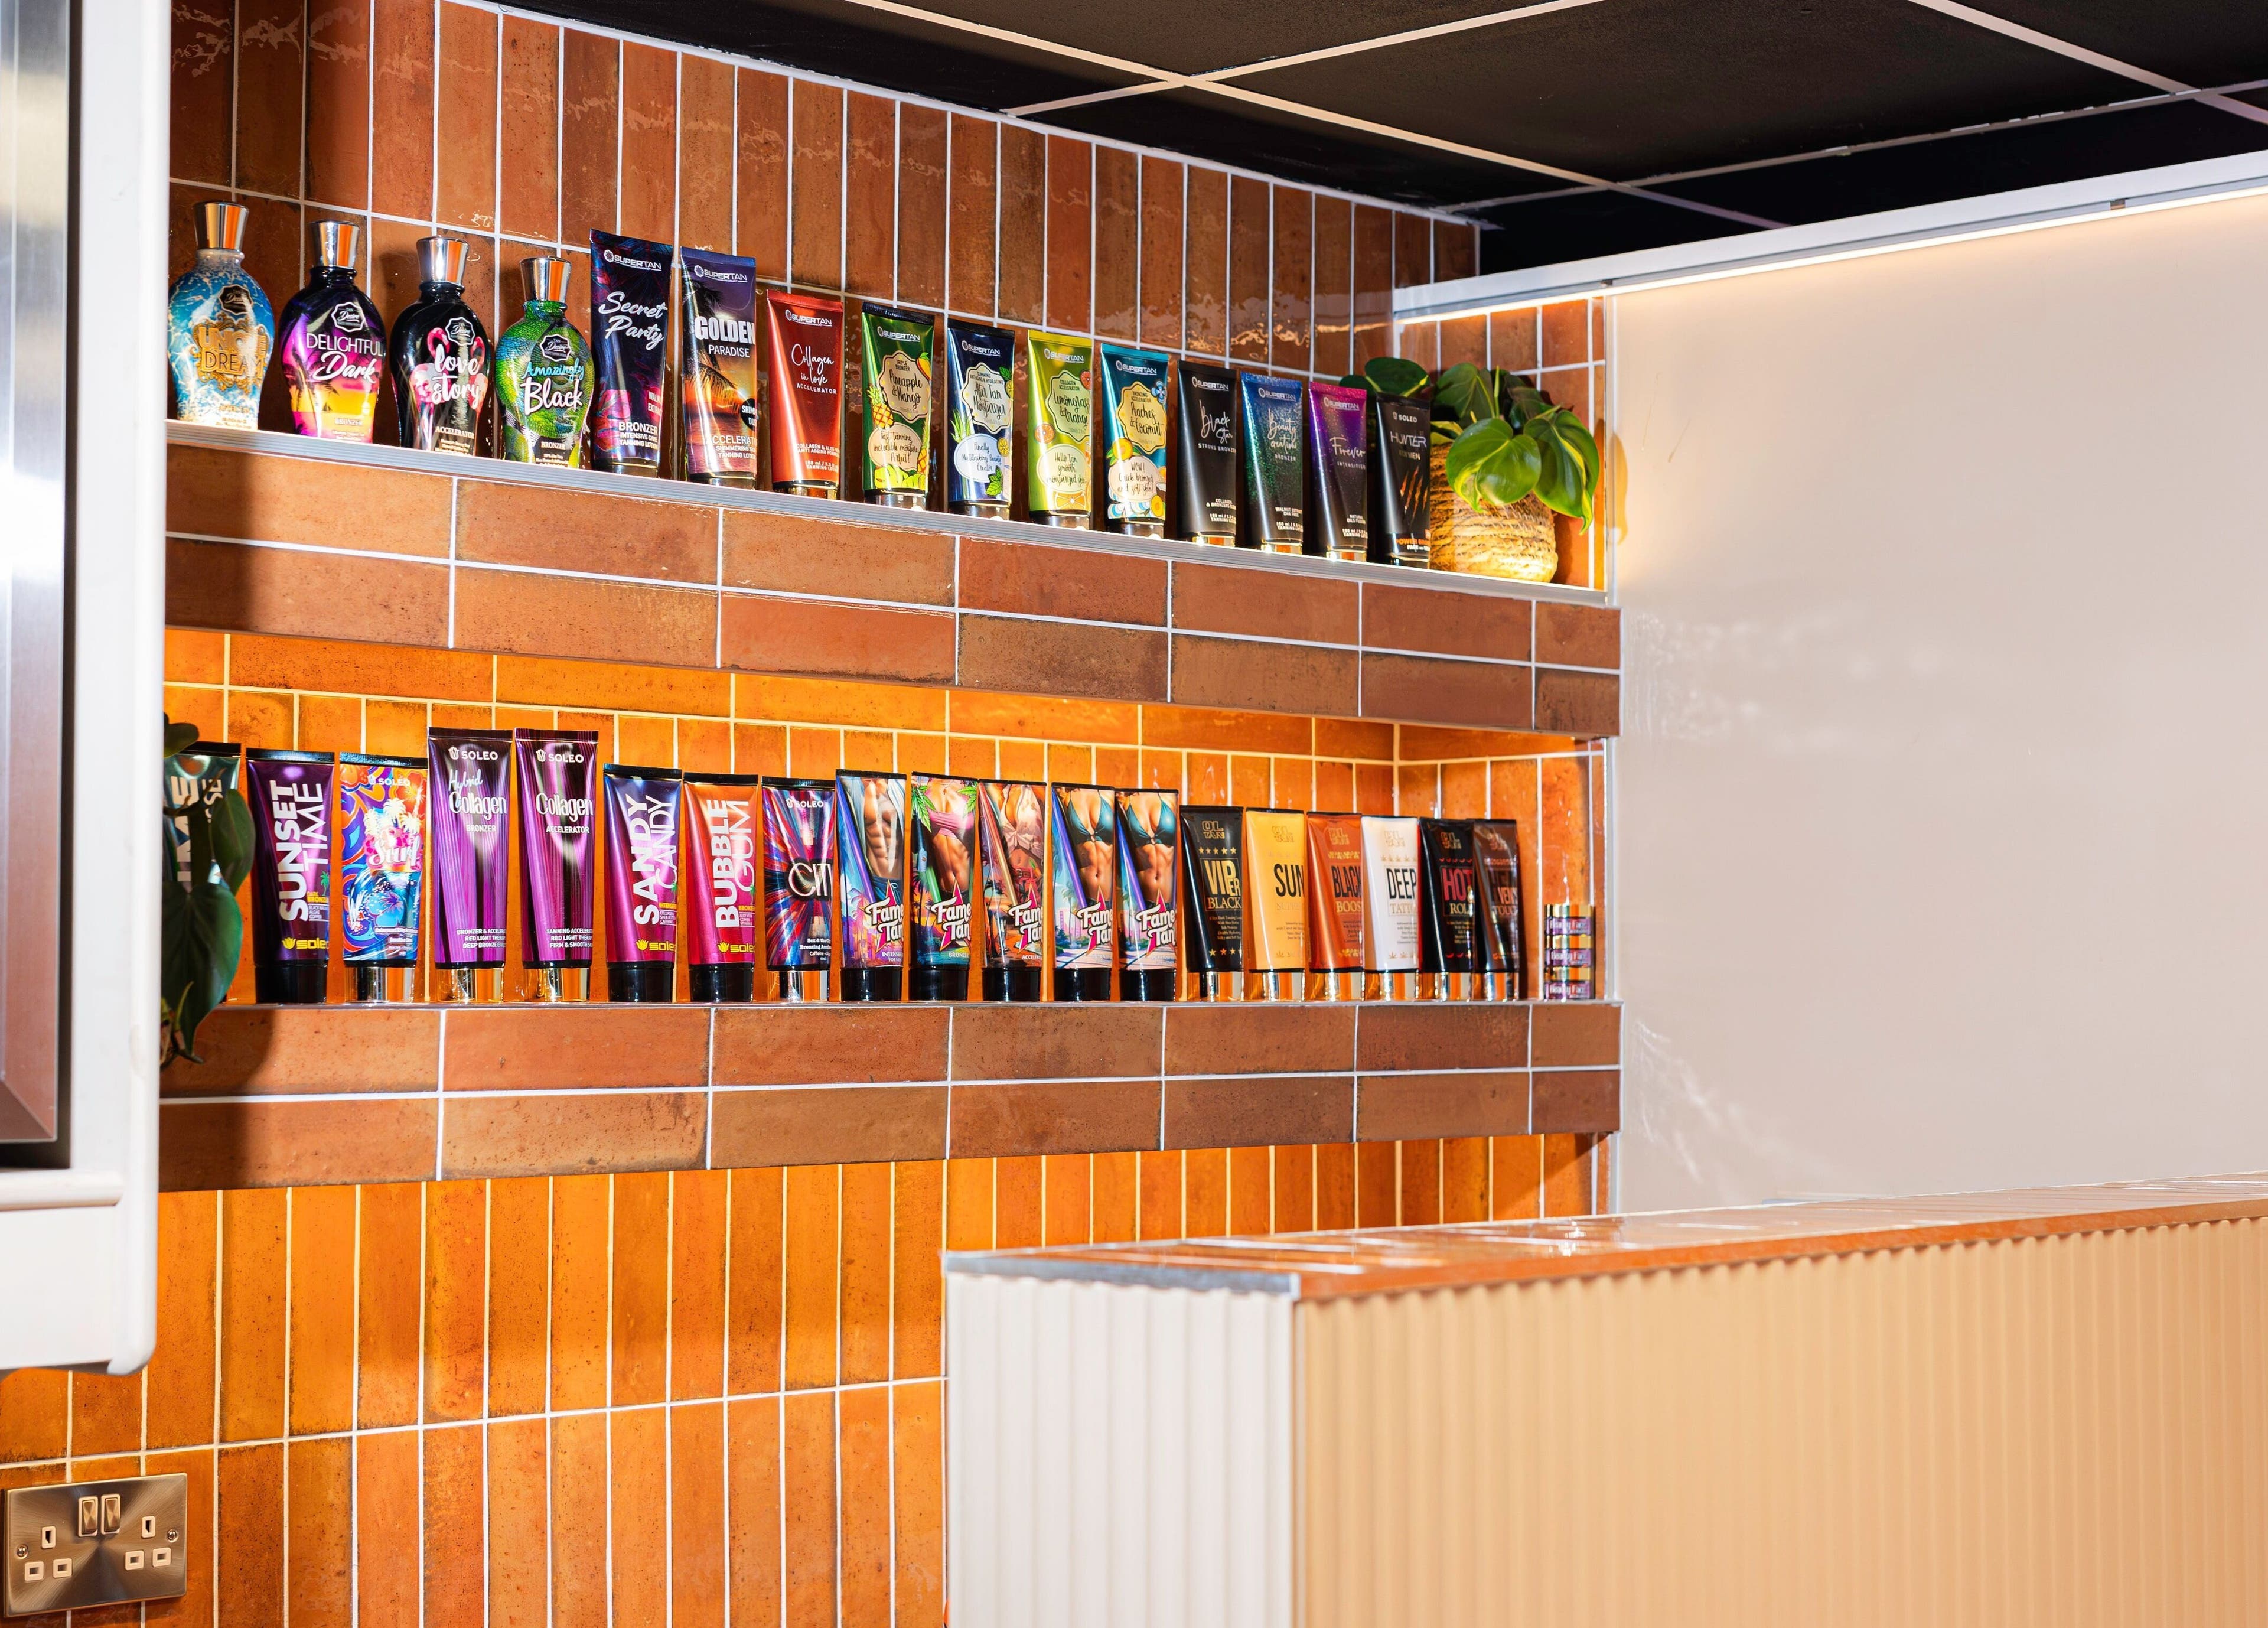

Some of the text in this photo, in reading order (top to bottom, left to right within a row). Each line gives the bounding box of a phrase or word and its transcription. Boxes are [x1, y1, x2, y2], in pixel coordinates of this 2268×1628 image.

[614, 255, 662, 269] SUPERTAN
[704, 269, 748, 281] SUPERTAN
[598, 291, 667, 319] Secret
[694, 316, 755, 344] GOLDEN
[791, 314, 832, 325] SUPERTAN
[605, 315, 664, 350] Party
[883, 330, 920, 340] SUPERTAN
[307, 333, 383, 356] DELIGHTFUL
[709, 344, 750, 358] PARADISE
[968, 344, 1000, 355] SUPERTAN
[312, 351, 377, 383] Dark
[435, 343, 480, 376] love
[791, 343, 834, 375] Collagen
[1051, 351, 1084, 362] SUPERTAN
[521, 357, 584, 380] Amazingly
[810, 367, 827, 386] love
[1122, 364, 1157, 375] SUPERTAN
[797, 383, 837, 395] ACCELERATOR
[889, 369, 922, 392] Pineapple
[1197, 380, 1228, 390] SUPERTAN
[431, 375, 480, 409] story
[520, 377, 583, 415] Black
[892, 385, 921, 409] & Mango
[988, 384, 1002, 399] Tan
[1265, 391, 1296, 399] SUPERTAN
[1330, 401, 1360, 411] SUPERTAN
[335, 418, 363, 426] BRONZER
[618, 422, 658, 435] BRONZER
[1135, 418, 1161, 436] Coconut
[1267, 408, 1297, 443] Beauty
[1399, 414, 1418, 423] SOLEO
[435, 426, 474, 439] ACCELERATOR
[1216, 426, 1233, 444] Star
[1390, 431, 1427, 448] HUNTER
[541, 441, 565, 450] BRONZER
[1408, 452, 1420, 460] MEN
[461, 751, 498, 760] SOLEO
[548, 754, 584, 763] SOLEO
[378, 777, 410, 786] SOLEO
[448, 769, 483, 796] Hybrid
[449, 791, 507, 820] Collagen
[536, 792, 593, 822] Collagen
[292, 783, 328, 871] TIME
[269, 780, 309, 922] SUNSET
[645, 795, 678, 888] CANDY
[726, 800, 755, 892] GUM
[625, 793, 660, 924] SANDY
[706, 799, 739, 928] BUBBLE
[788, 862, 833, 897] CIT
[1273, 864, 1305, 897] SUN
[1386, 868, 1417, 899] DEEP
[1442, 868, 1473, 901] HOT
[865, 897, 904, 924] Fame
[930, 896, 972, 924] Fame
[1208, 897, 1242, 909] BLACK
[1336, 900, 1361, 913] BOOS
[1076, 902, 1113, 929] Fame
[1135, 904, 1175, 931] Fame
[877, 920, 904, 942] Tan
[942, 919, 971, 940] Tan
[1088, 924, 1113, 945] Tan
[1147, 926, 1175, 946] Tan
